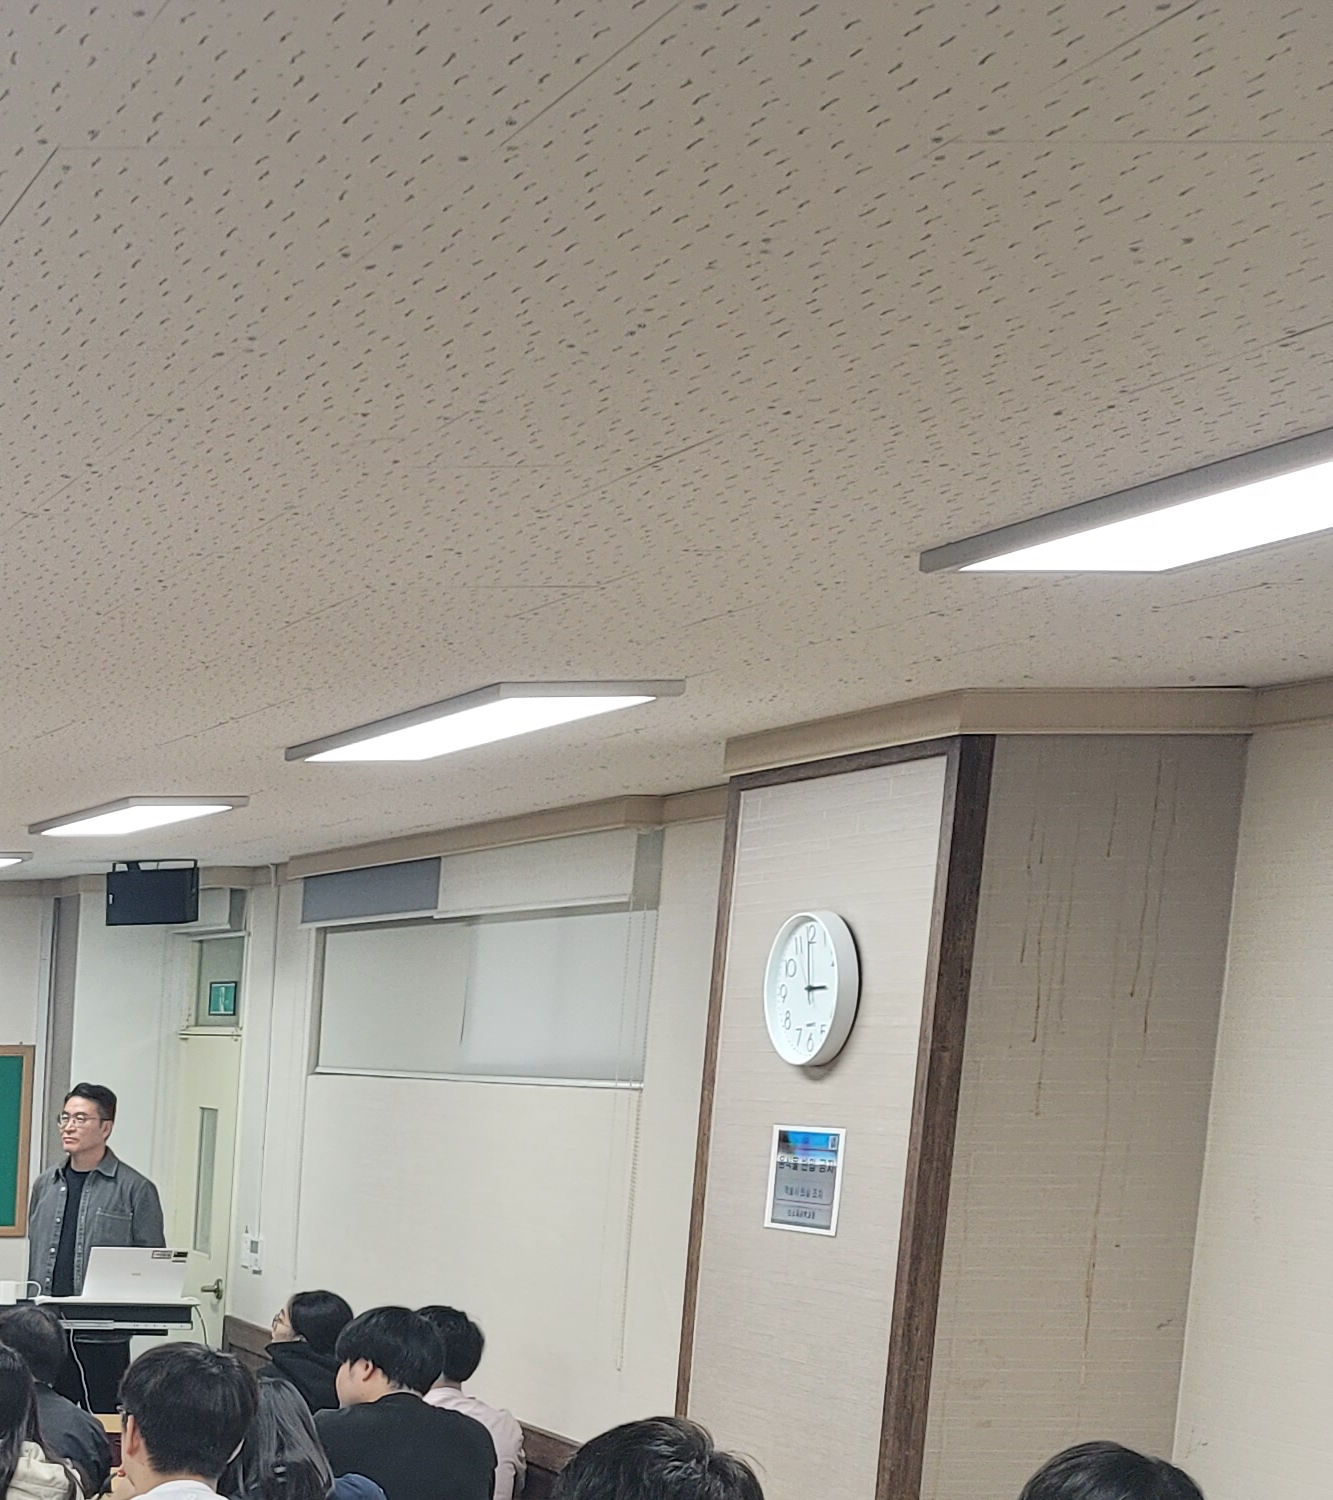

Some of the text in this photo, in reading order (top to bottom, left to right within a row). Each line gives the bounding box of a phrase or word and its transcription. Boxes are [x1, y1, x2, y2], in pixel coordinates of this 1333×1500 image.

[794, 936, 804, 955] 11
[784, 958, 797, 978] 10
[779, 984, 788, 1004] 9
[784, 1010, 792, 1031] 8
[795, 1027, 803, 1047] 7
[806, 1032, 815, 1053] 6
